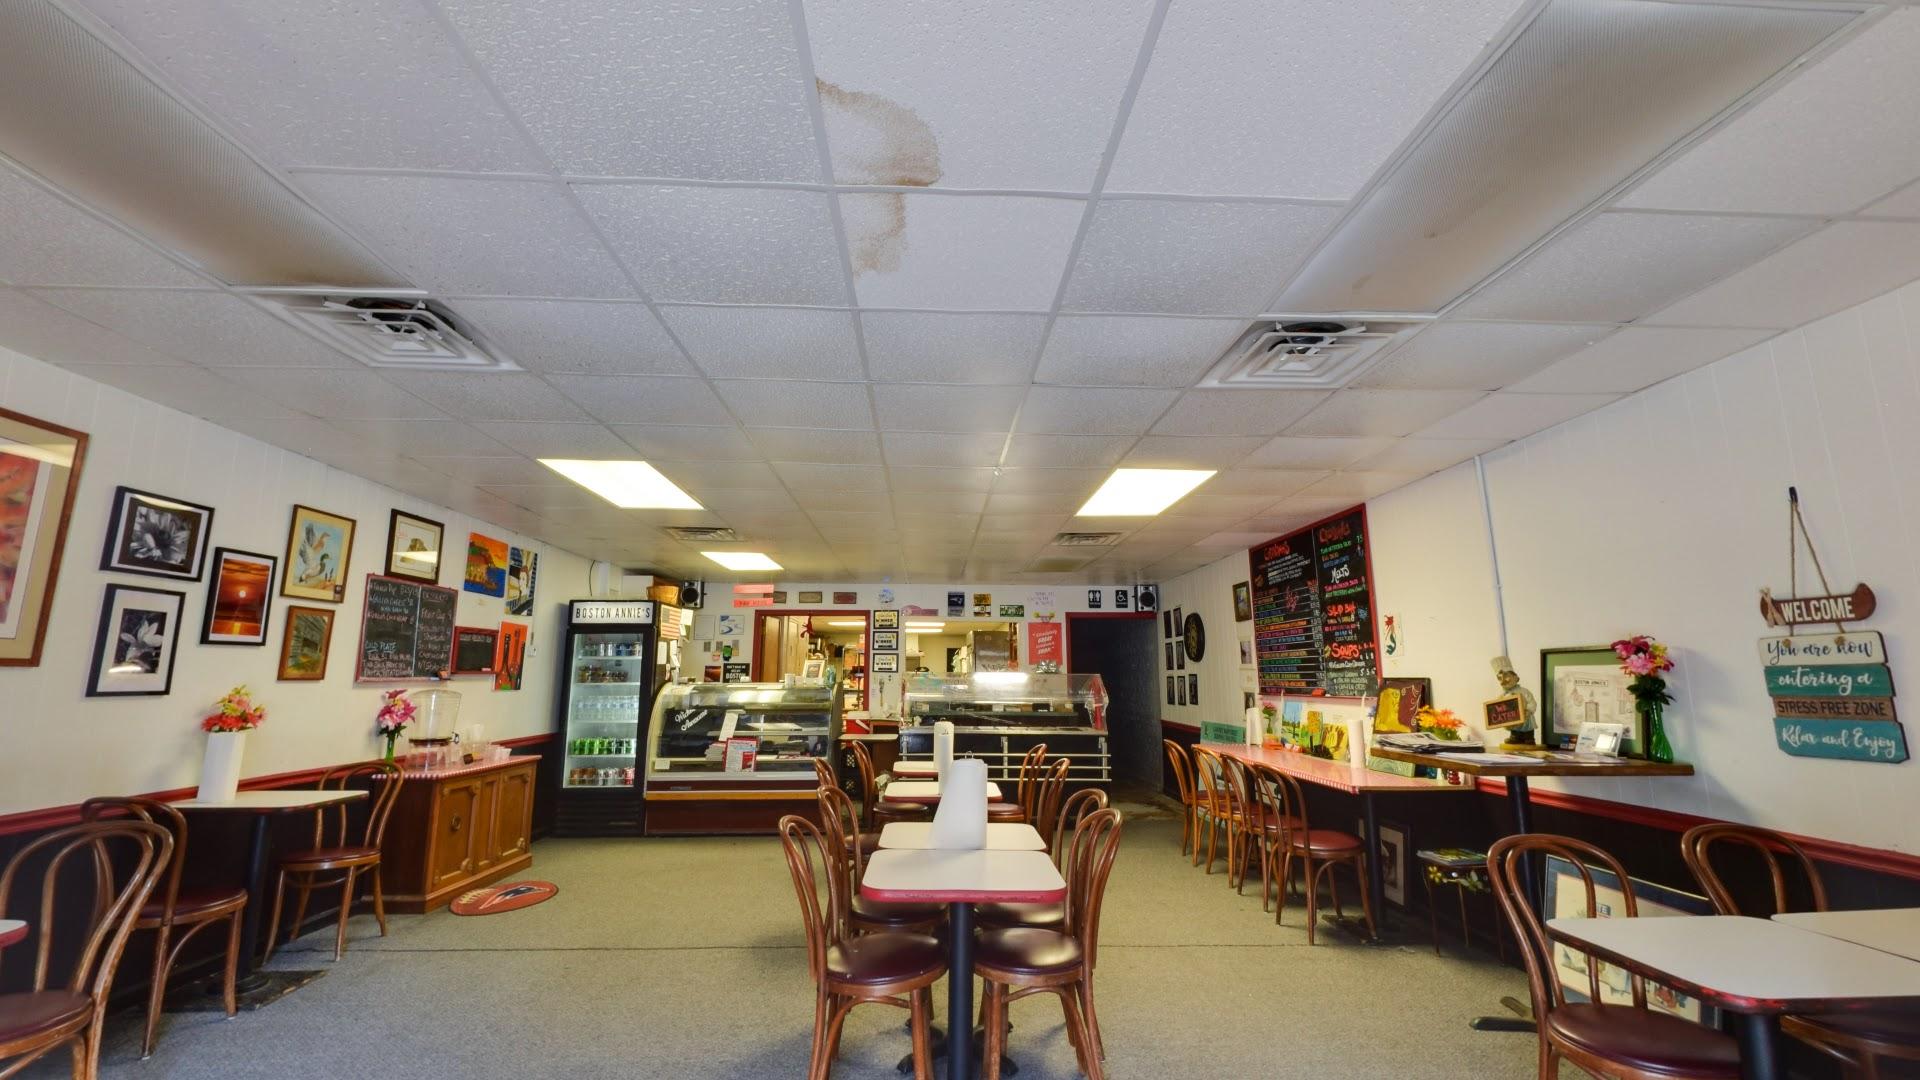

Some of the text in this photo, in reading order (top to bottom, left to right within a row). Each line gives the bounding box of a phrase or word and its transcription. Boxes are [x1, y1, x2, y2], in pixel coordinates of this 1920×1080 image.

[576, 607, 650, 618] BOSTON ANNIE'S
[1781, 597, 1855, 622] WELCOME
[1332, 643, 1360, 658] SOUPS
[1767, 640, 1873, 665] You are now
[1779, 667, 1872, 695] entering a
[1778, 701, 1889, 716] STRESS FREE ZONE
[1782, 725, 1896, 758] Relax and Enjoy
